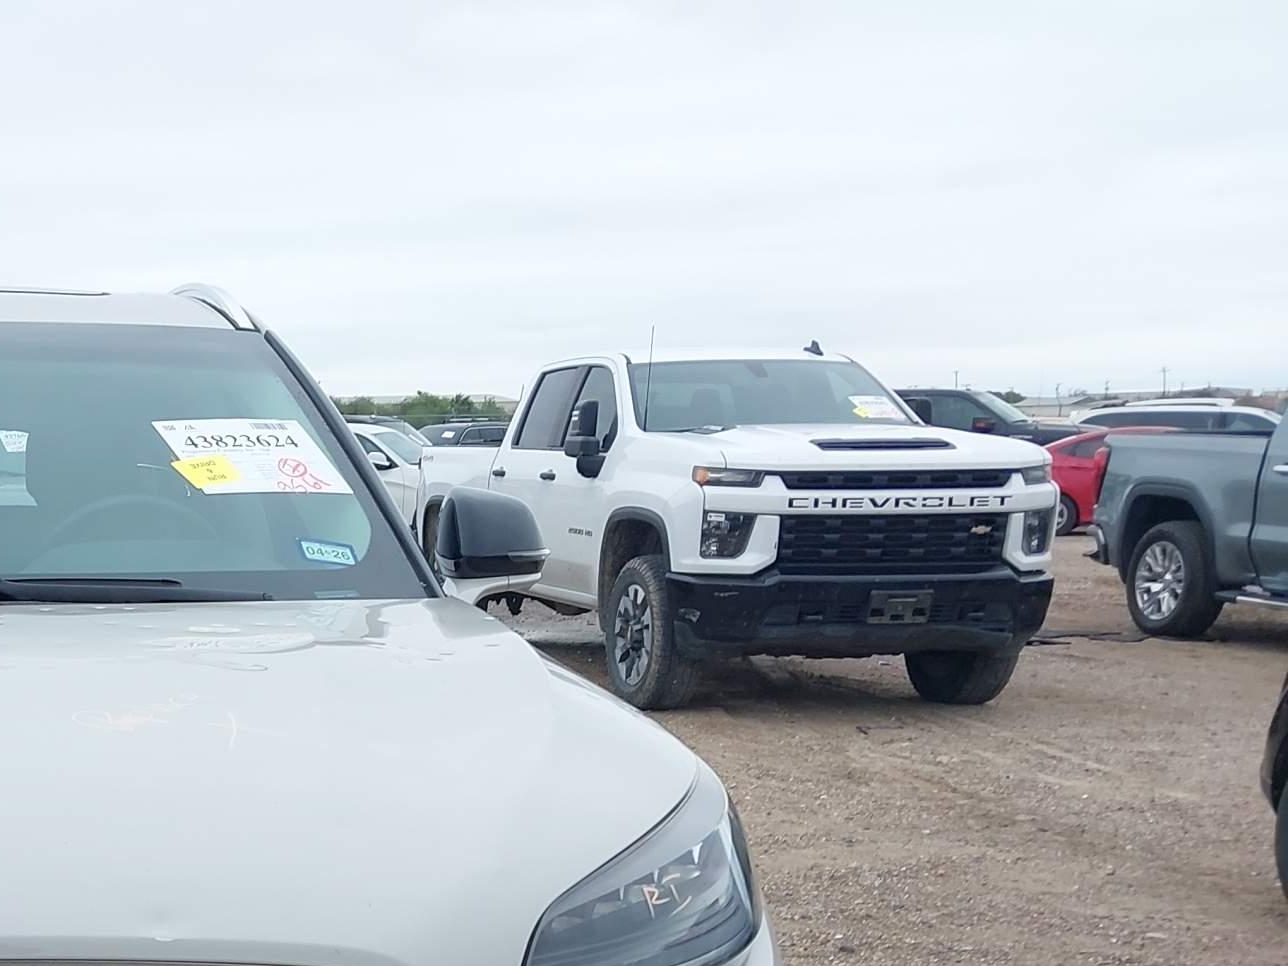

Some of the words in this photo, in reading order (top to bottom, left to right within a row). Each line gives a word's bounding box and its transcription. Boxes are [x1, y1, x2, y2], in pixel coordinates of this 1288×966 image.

[184, 434, 299, 449] 43823624
[787, 495, 1013, 509] CHEVROLET
[305, 545, 351, 561] 04-26
